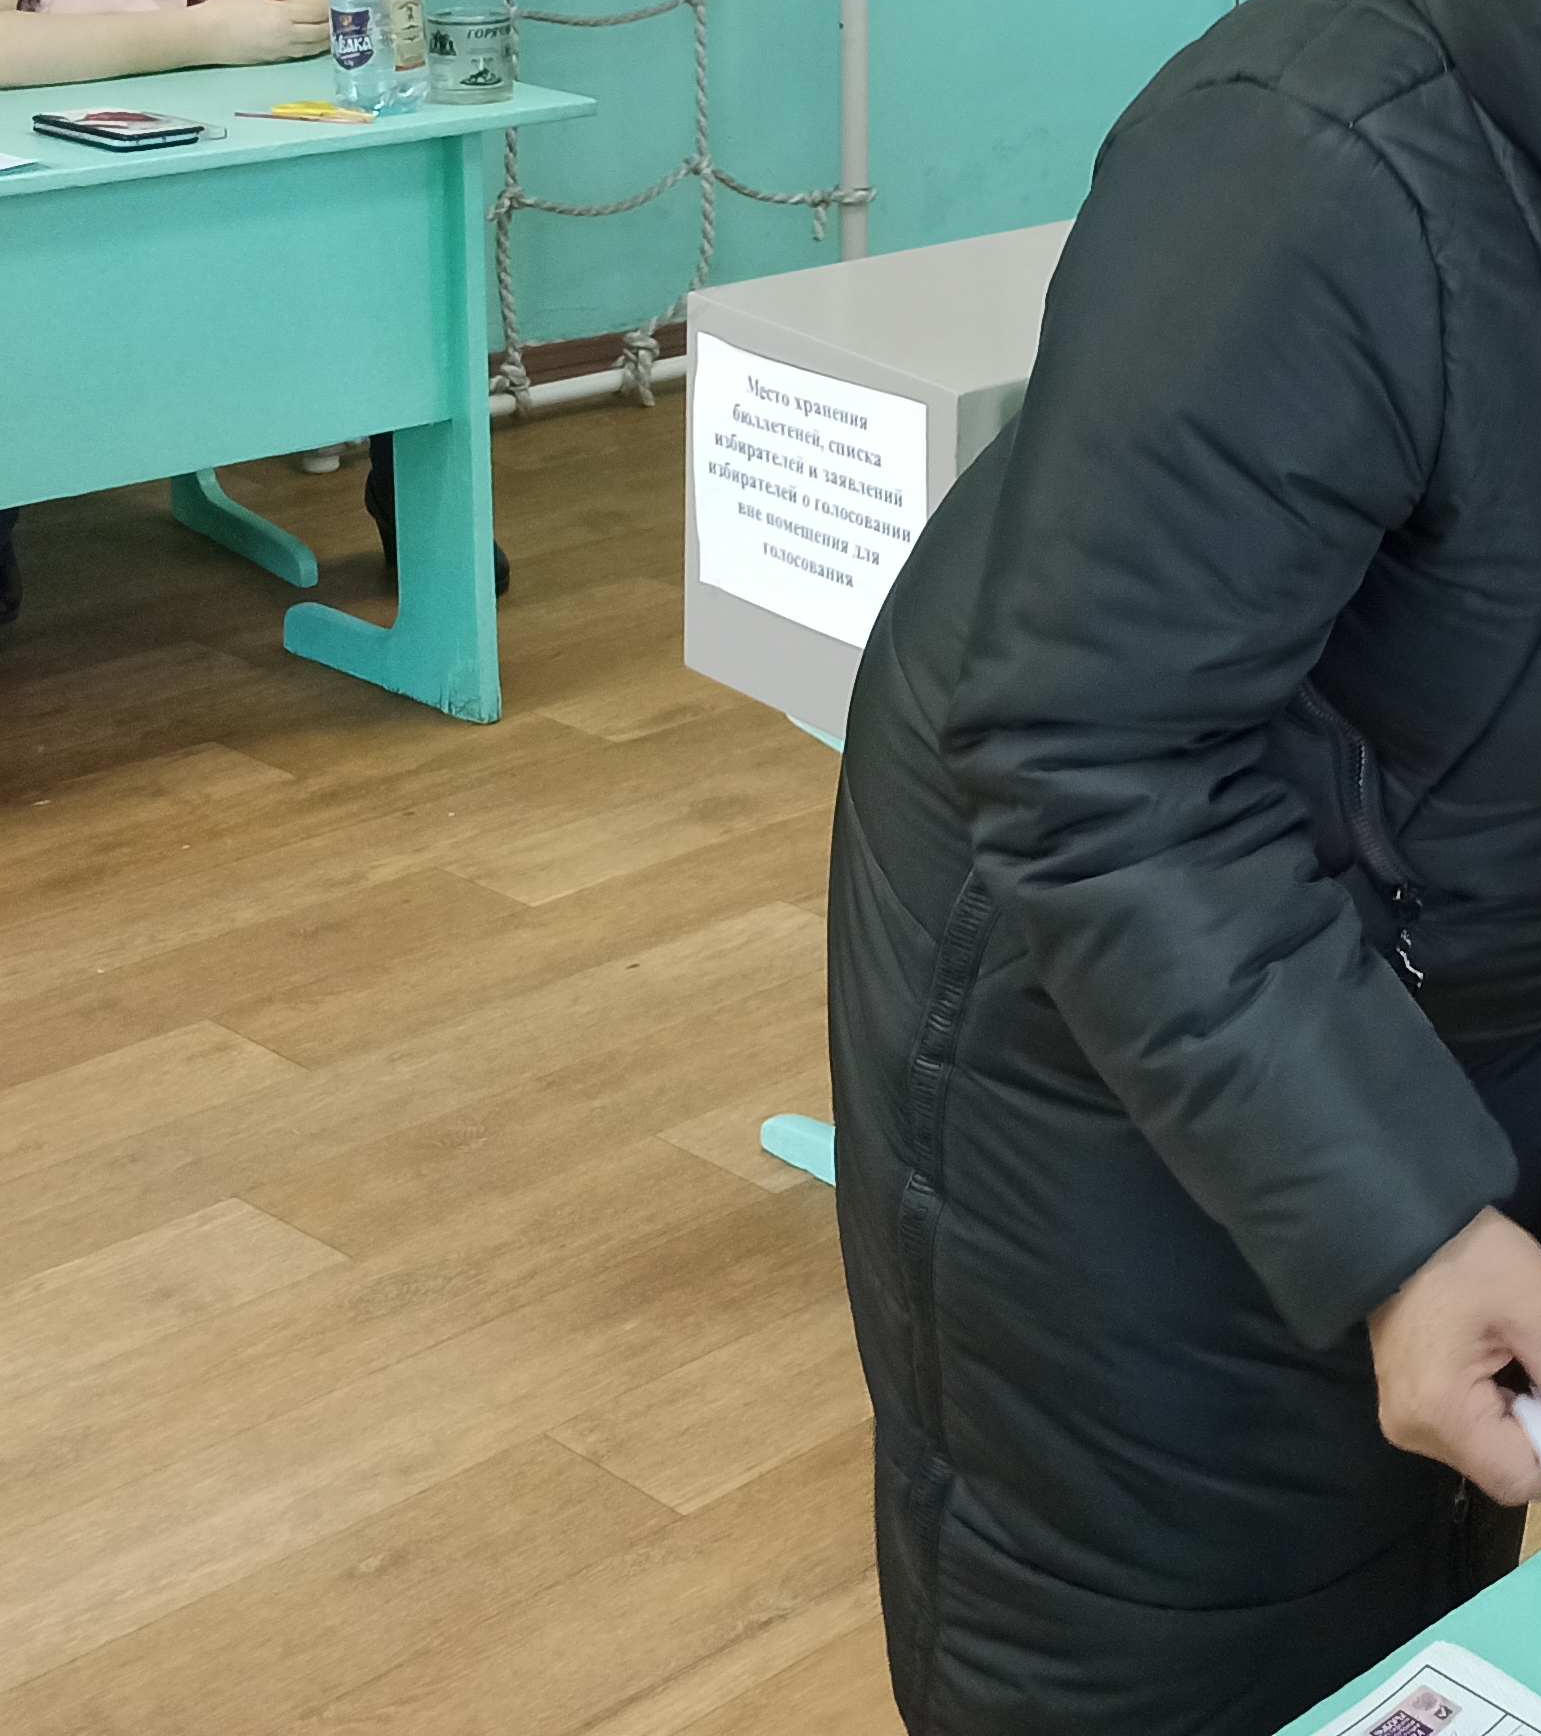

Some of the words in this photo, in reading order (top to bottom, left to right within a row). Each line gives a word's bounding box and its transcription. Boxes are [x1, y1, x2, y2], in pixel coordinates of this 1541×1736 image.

[732, 402, 825, 452] бюллетеней,
[828, 438, 882, 469] списка
[746, 374, 791, 408] Место
[793, 395, 868, 432] хранения
[708, 459, 798, 505] избирателей
[802, 493, 811, 509] о
[814, 497, 912, 544] голосовании
[714, 432, 805, 475] избирателей
[808, 463, 819, 480] и
[822, 468, 904, 509] заявлений
[738, 500, 763, 522] вне
[766, 510, 850, 555] помещения
[852, 543, 881, 566] для
[763, 540, 855, 588] голосования
